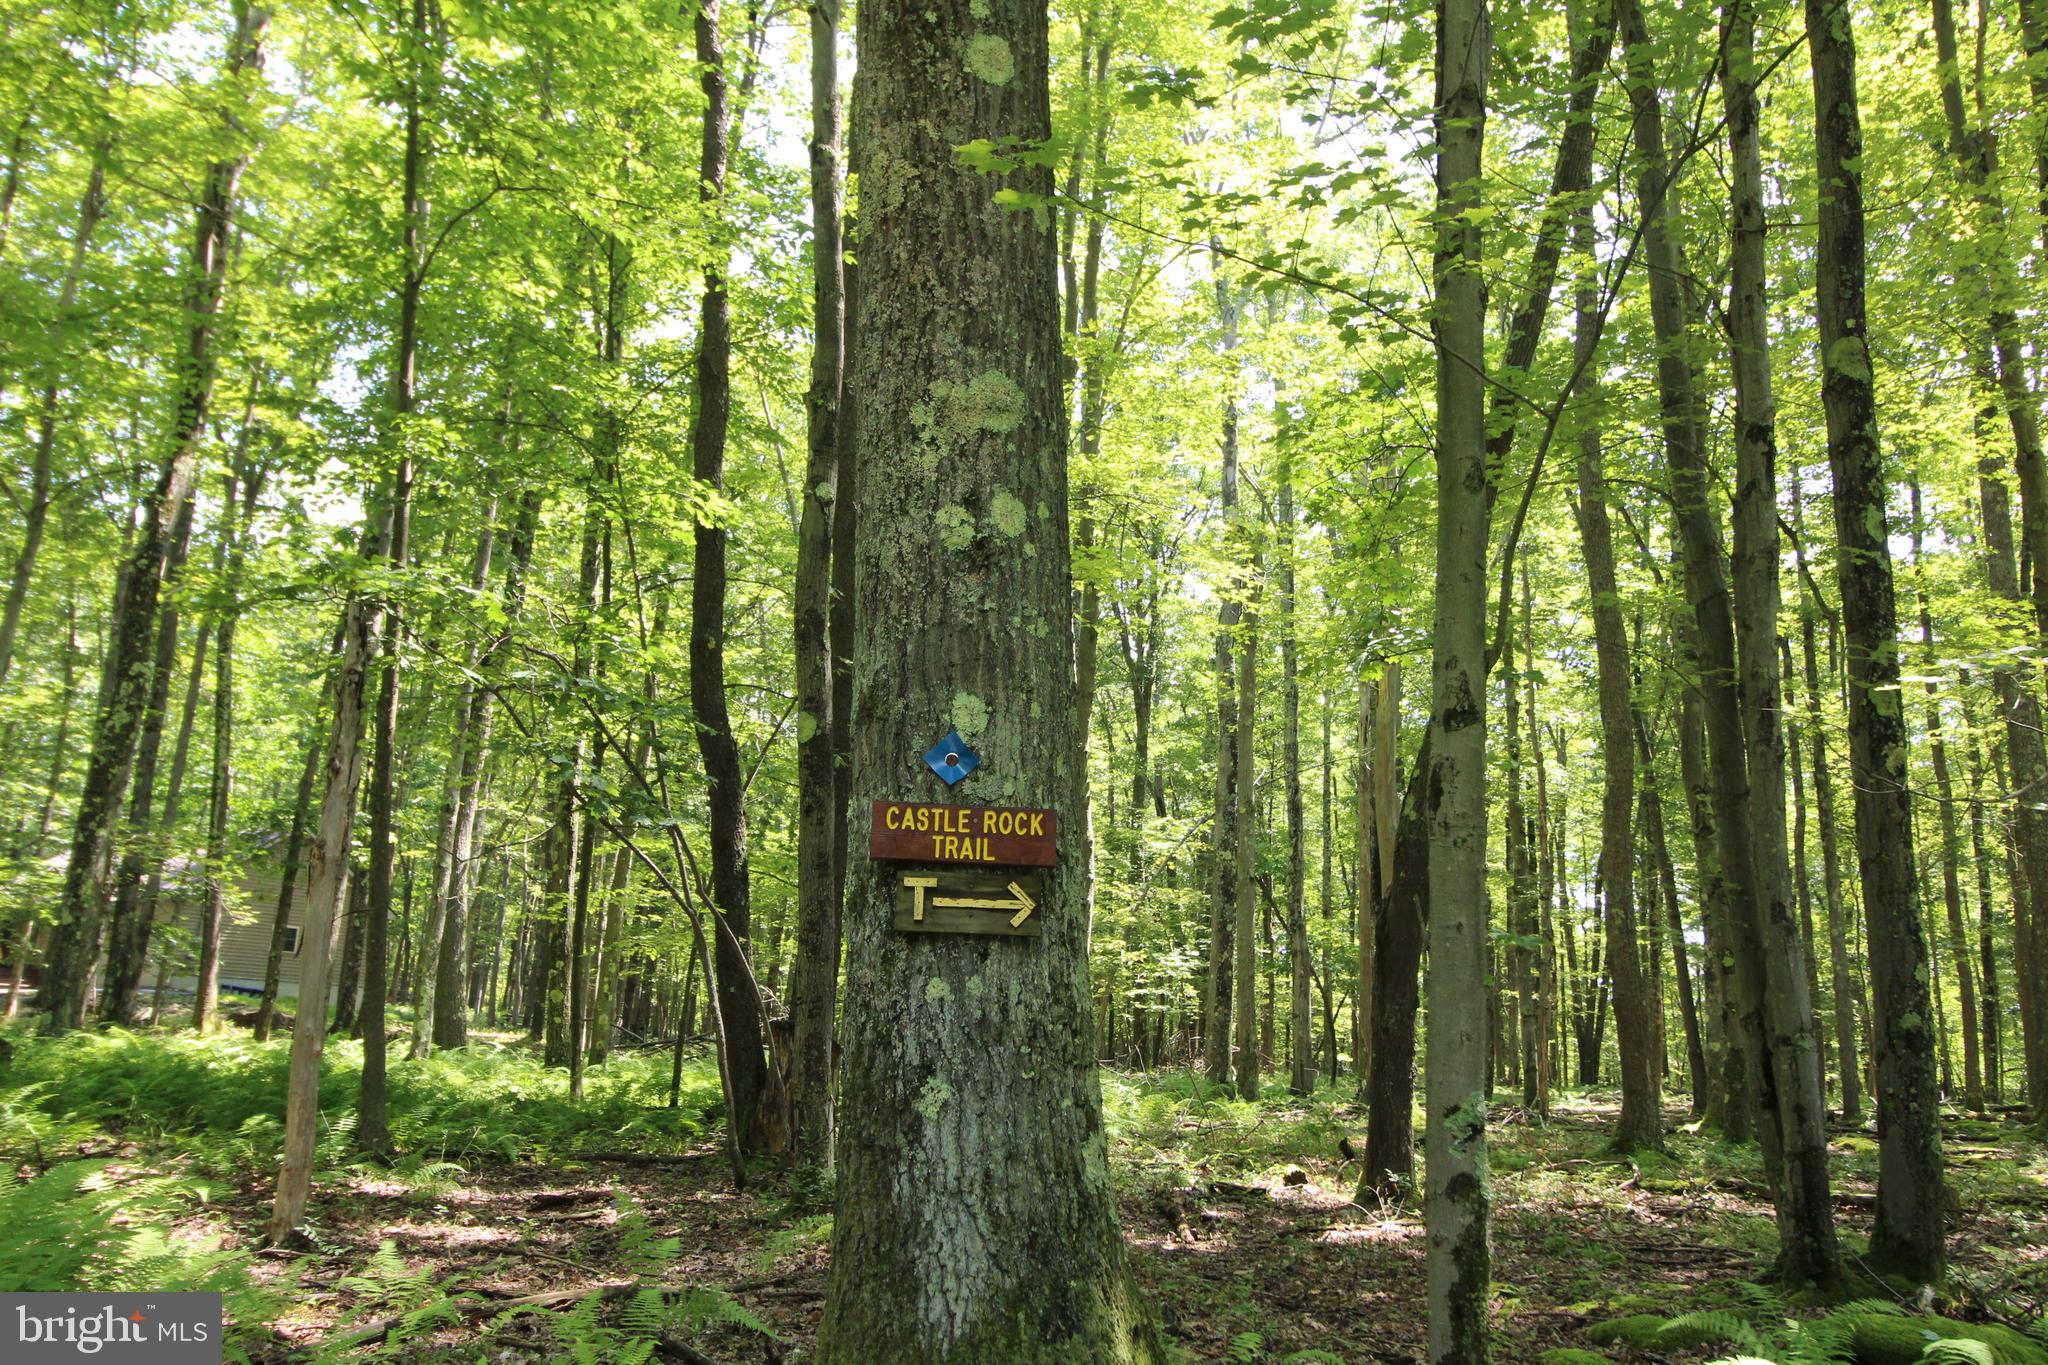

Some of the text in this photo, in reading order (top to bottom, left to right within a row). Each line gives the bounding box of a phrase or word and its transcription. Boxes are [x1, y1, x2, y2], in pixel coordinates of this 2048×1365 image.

[886, 805, 1044, 836] CASTLE ROCK
[932, 835, 995, 861] TRAIL
